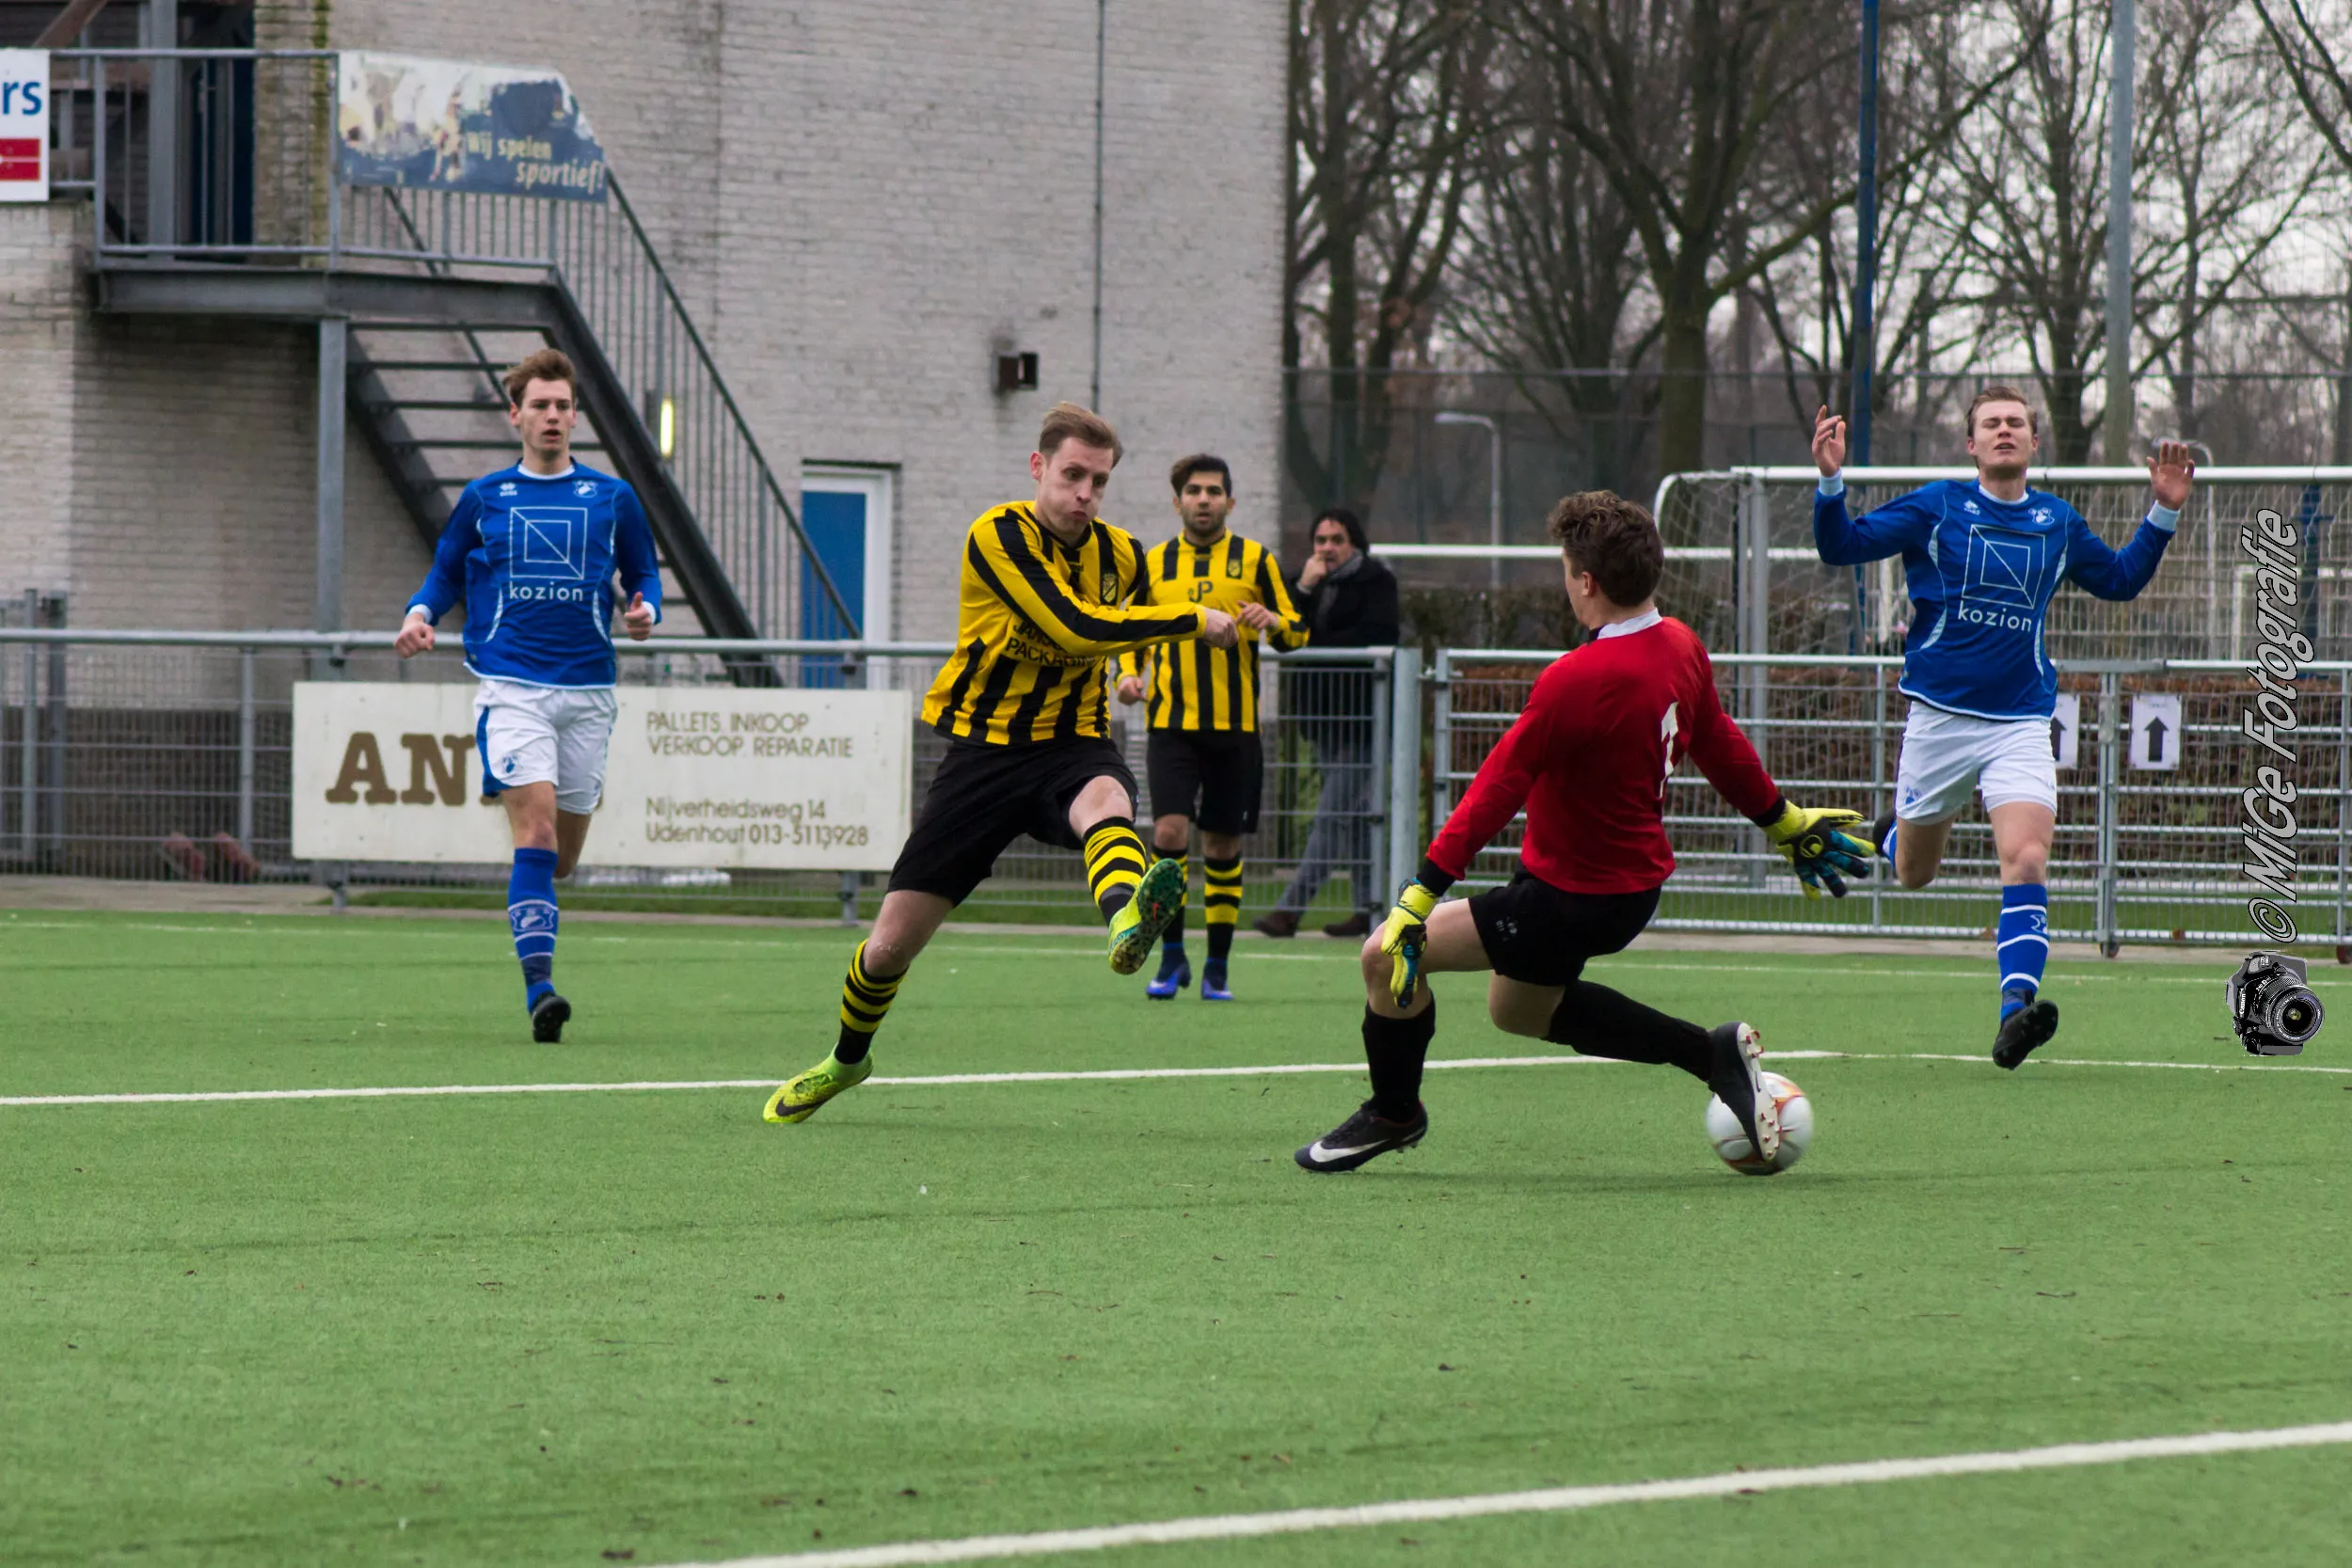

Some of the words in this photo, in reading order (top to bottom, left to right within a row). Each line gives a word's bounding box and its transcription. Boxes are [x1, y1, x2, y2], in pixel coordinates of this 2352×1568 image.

[2, 81, 42, 115] rs
[498, 135, 552, 161] spelen
[516, 158, 605, 195] sportief!
[509, 580, 583, 601] kozion
[1957, 600, 2032, 632] kozion
[646, 711, 721, 733] PALLETS
[730, 712, 809, 734] INKOOP
[647, 735, 744, 756] VERKOOP
[753, 736, 853, 758] REPARATIE
[645, 798, 803, 825] Nijverheidsweg
[808, 800, 826, 819] 14
[645, 822, 745, 845] Udenhout
[749, 824, 869, 848] 013-5113928
